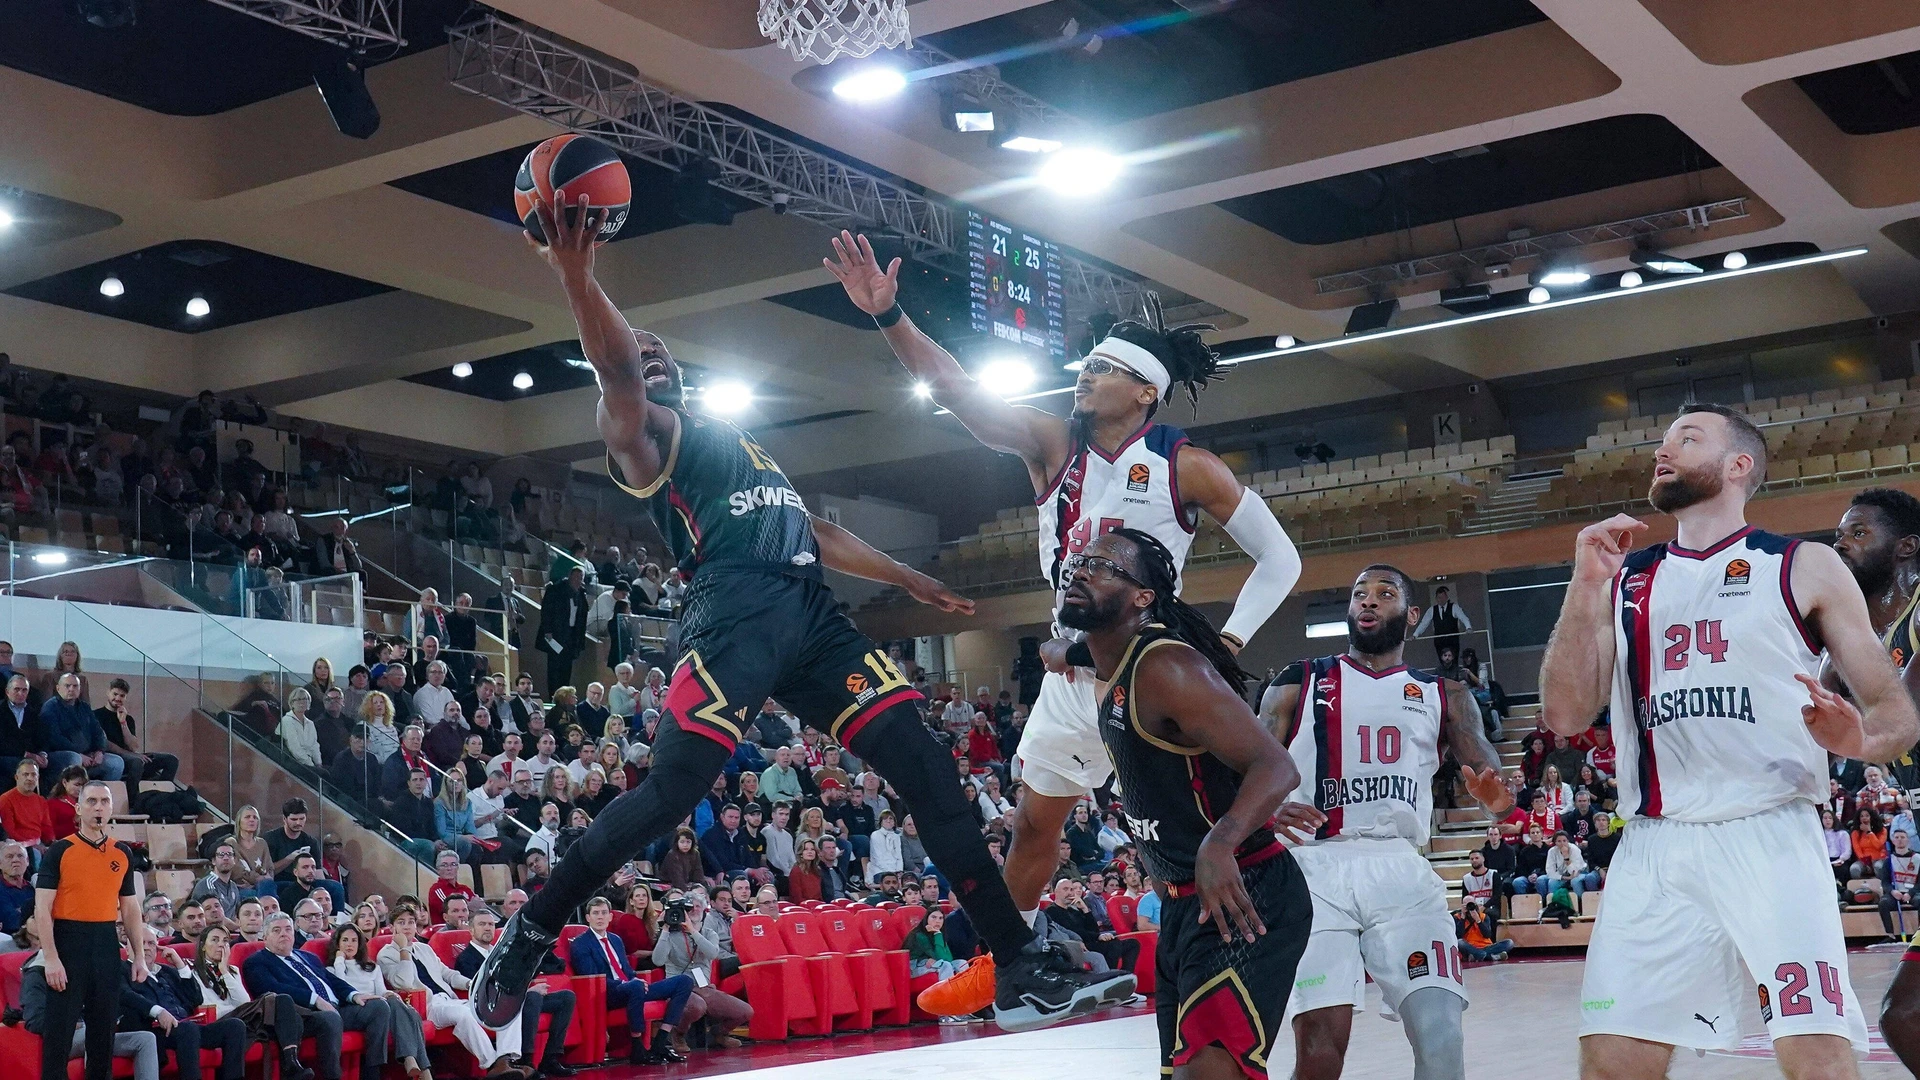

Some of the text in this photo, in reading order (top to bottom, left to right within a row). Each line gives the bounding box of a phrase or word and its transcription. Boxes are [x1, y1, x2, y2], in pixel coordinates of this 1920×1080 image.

[992, 233, 1007, 257] 21
[1025, 247, 1040, 270] 25
[1007, 280, 1031, 304] 8:24
[1438, 414, 1454, 436] K
[728, 485, 807, 516] SKWE
[1717, 590, 1751, 598] oneteam
[1664, 618, 1729, 671] 24
[1638, 686, 1756, 735] BASKONIA
[1357, 725, 1402, 764] 10
[1323, 774, 1418, 812] BASKONIA
[1123, 811, 1160, 842] EEK
[1431, 940, 1464, 986] 10
[1774, 960, 1845, 1018] 24
